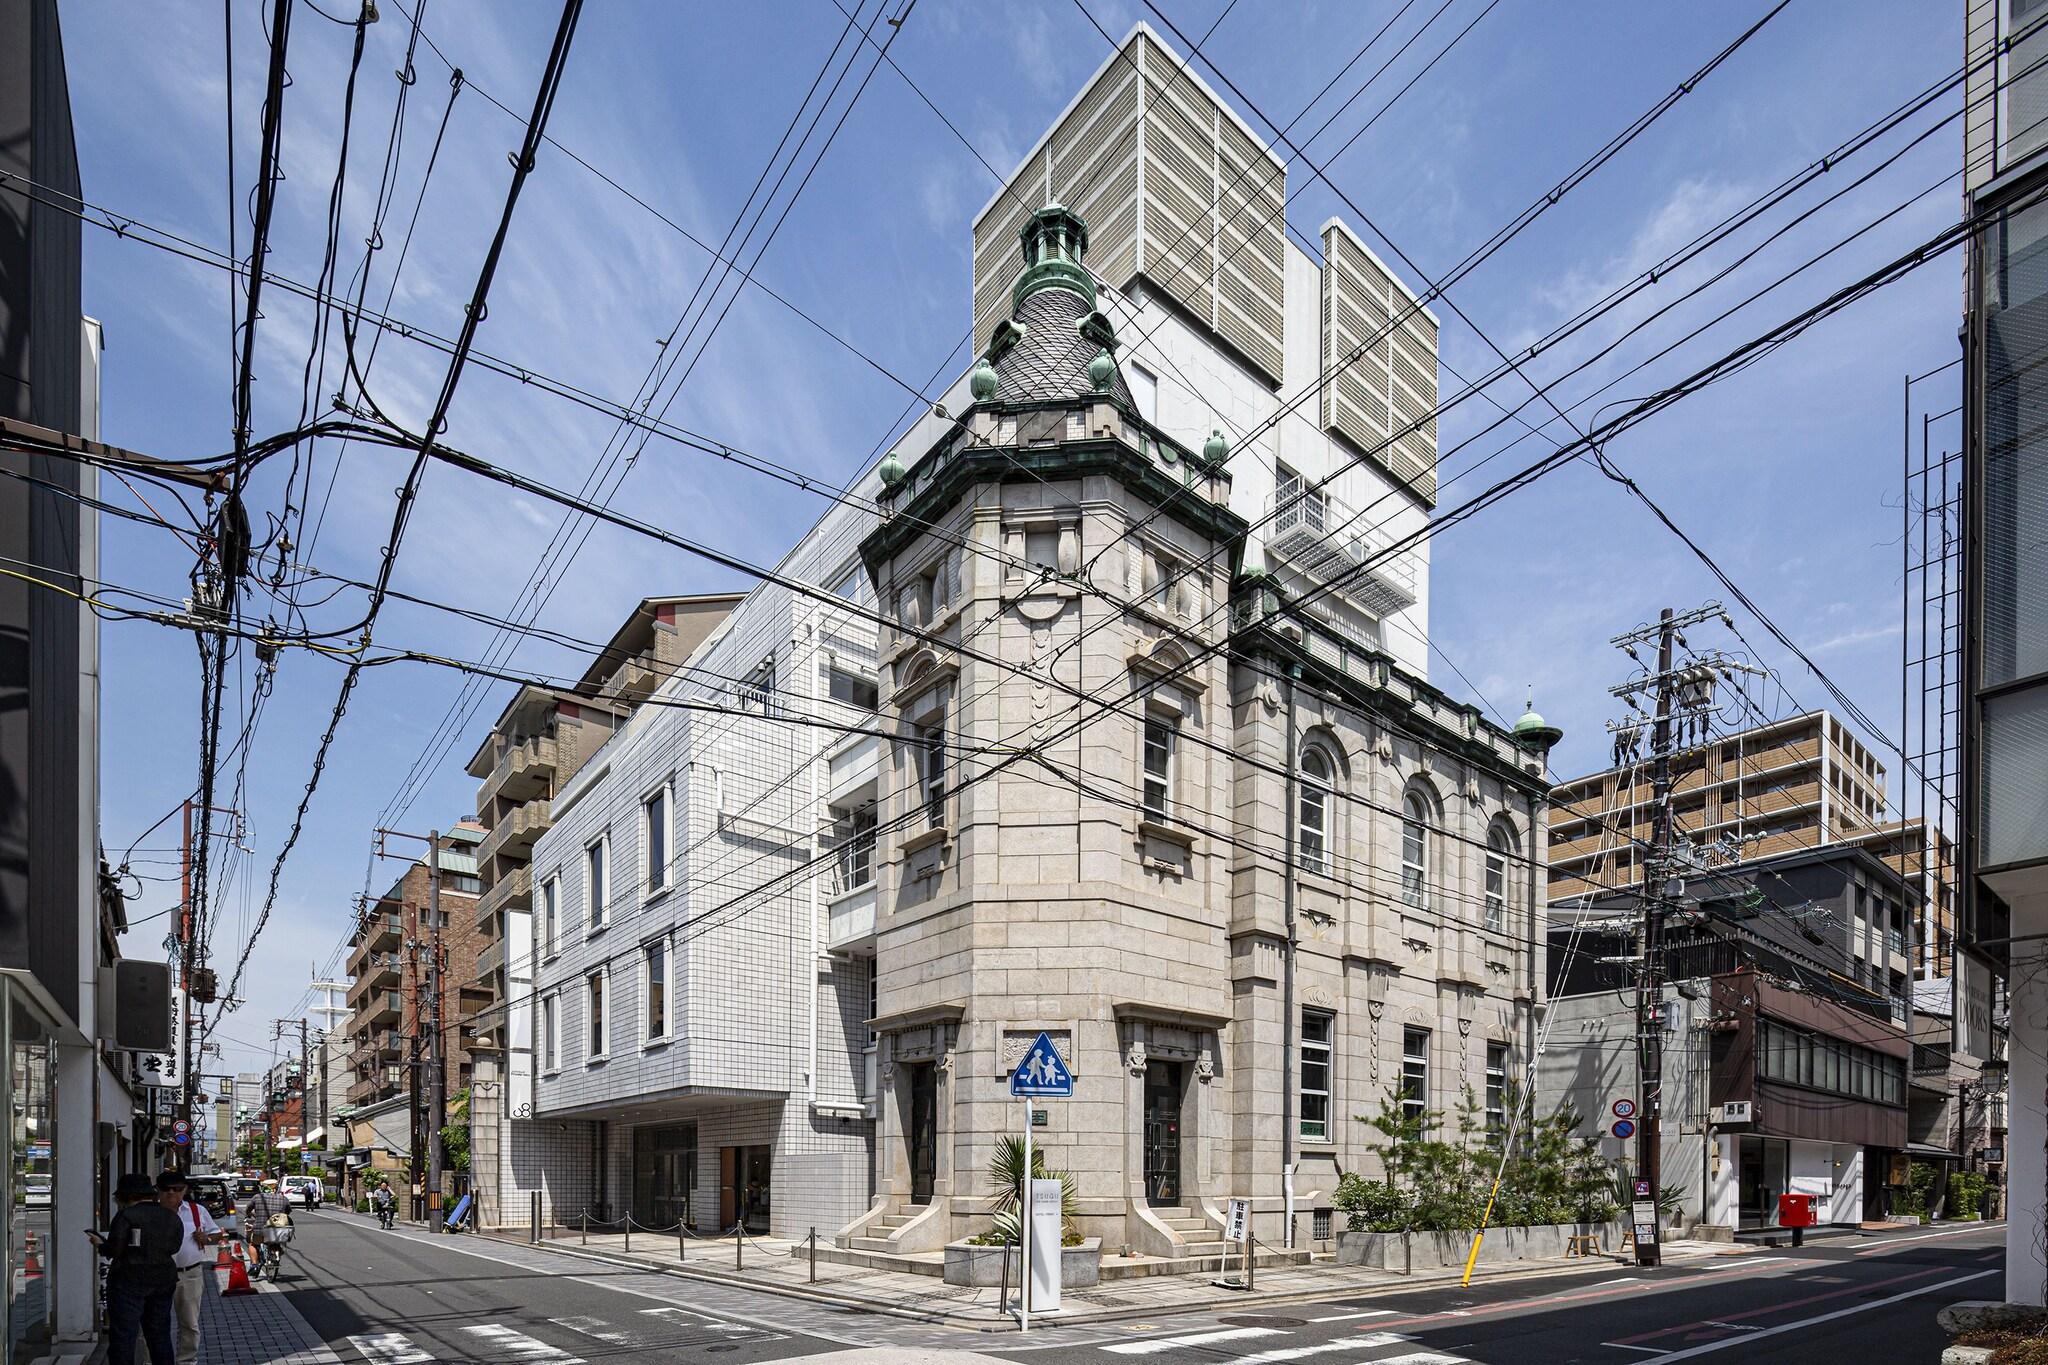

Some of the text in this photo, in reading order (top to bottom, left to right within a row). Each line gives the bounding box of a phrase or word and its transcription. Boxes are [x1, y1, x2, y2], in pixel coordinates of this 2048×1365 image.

[1617, 1103, 1631, 1114] 20
[1233, 1201, 1245, 1240] 駐車禁止
